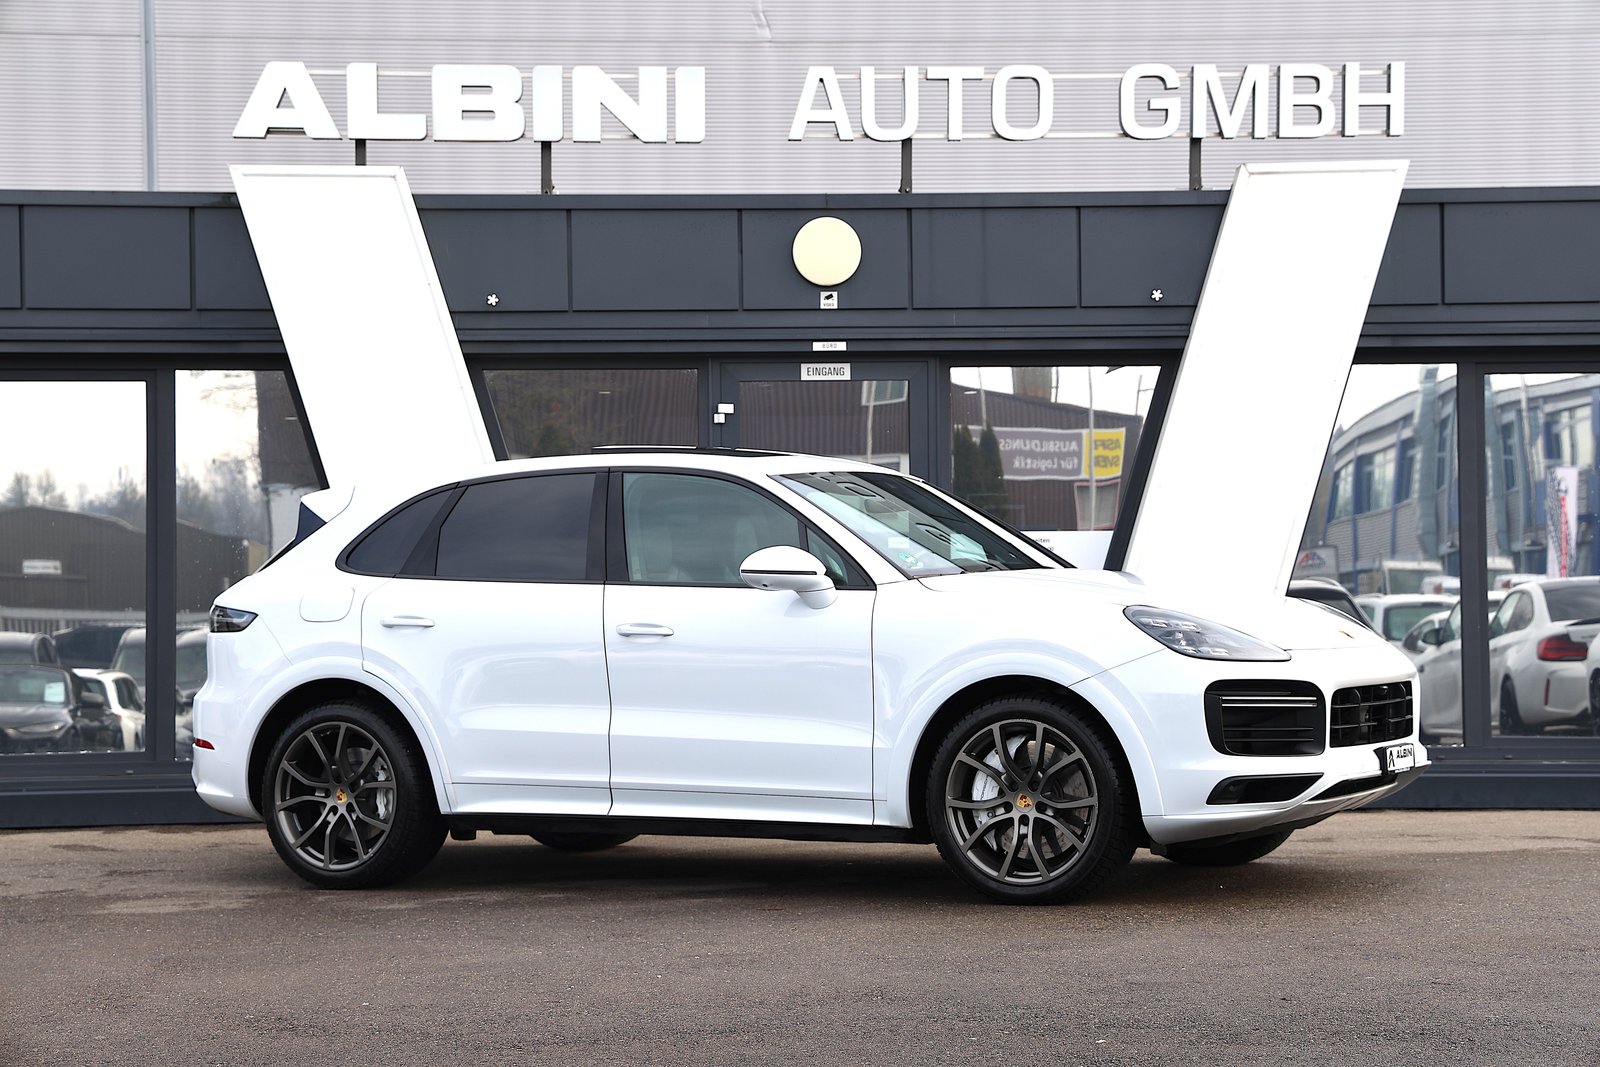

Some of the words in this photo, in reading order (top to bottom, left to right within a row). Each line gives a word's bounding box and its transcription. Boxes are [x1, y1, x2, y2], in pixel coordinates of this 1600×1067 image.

[233, 61, 706, 143] ALBINI
[788, 64, 1055, 142] AUTO
[1118, 61, 1405, 141] GMBH
[806, 366, 845, 376] EINGANG
